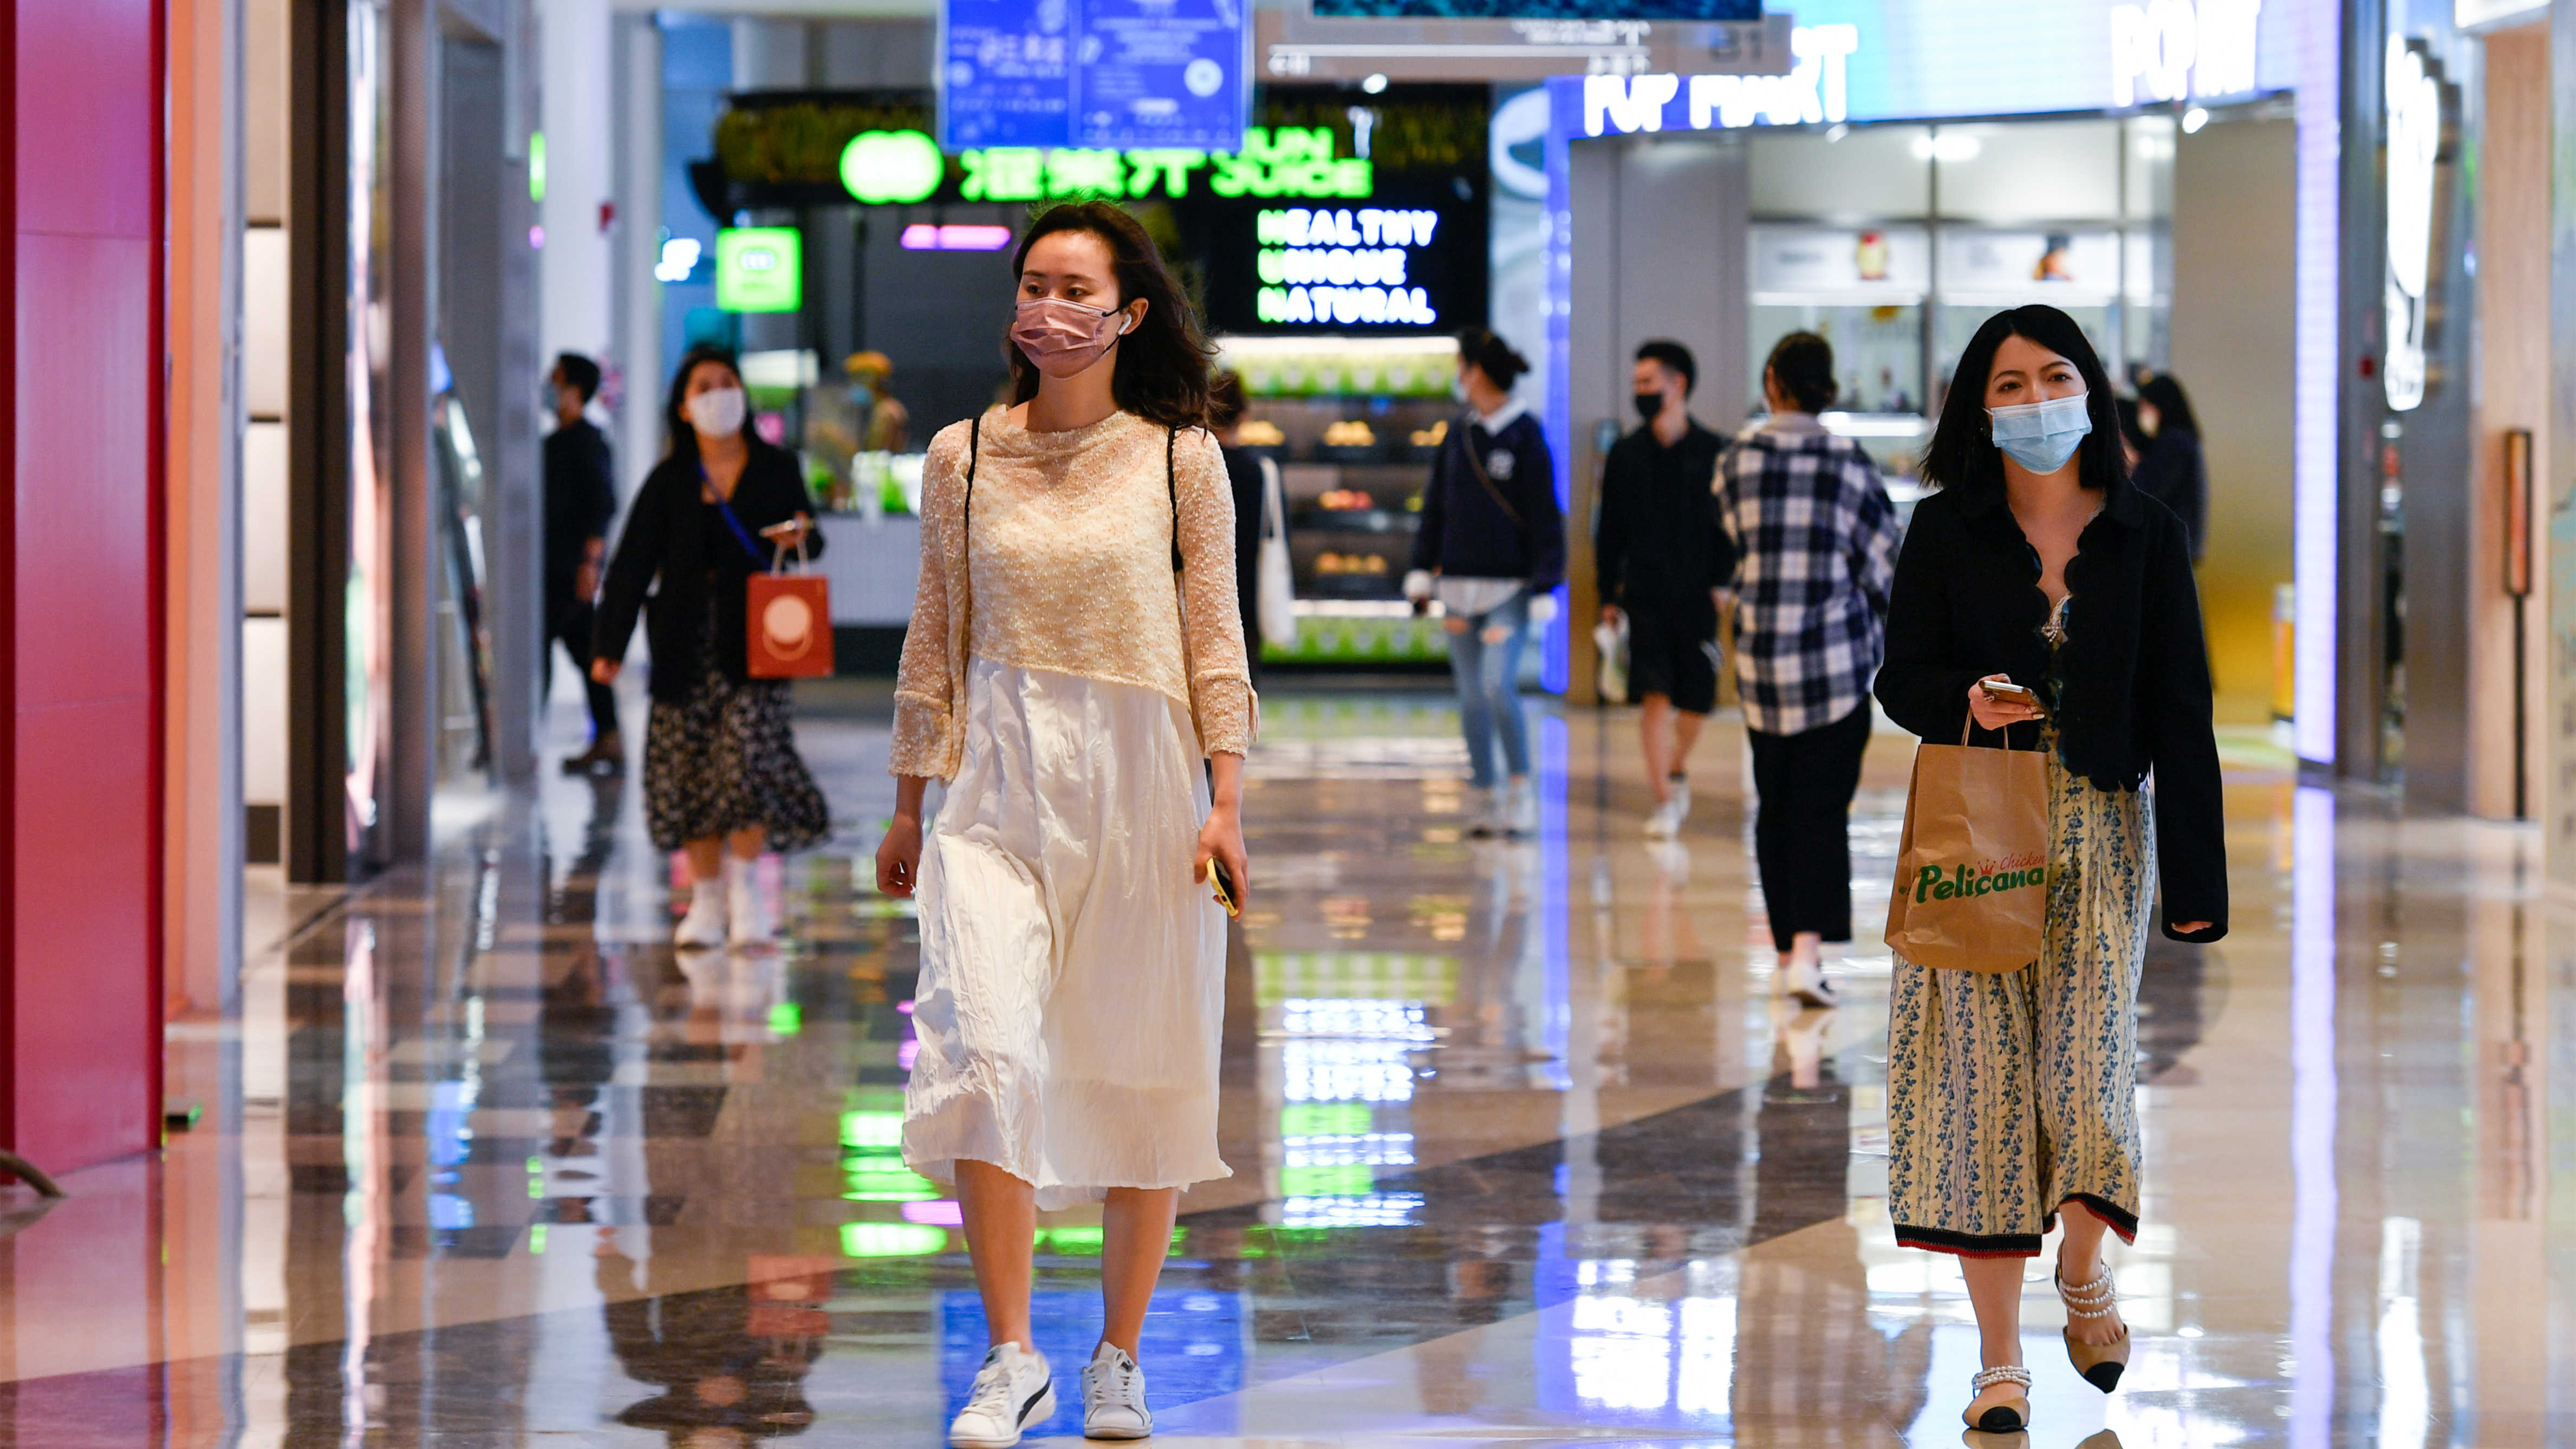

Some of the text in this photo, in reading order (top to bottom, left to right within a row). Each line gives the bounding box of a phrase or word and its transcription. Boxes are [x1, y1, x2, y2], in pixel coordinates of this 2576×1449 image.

[1258, 208, 1437, 246] HEALTHY
[1258, 286, 1436, 324] NATURAL
[2000, 852, 2046, 871] Chicken
[1915, 864, 2044, 904] Pelicana
